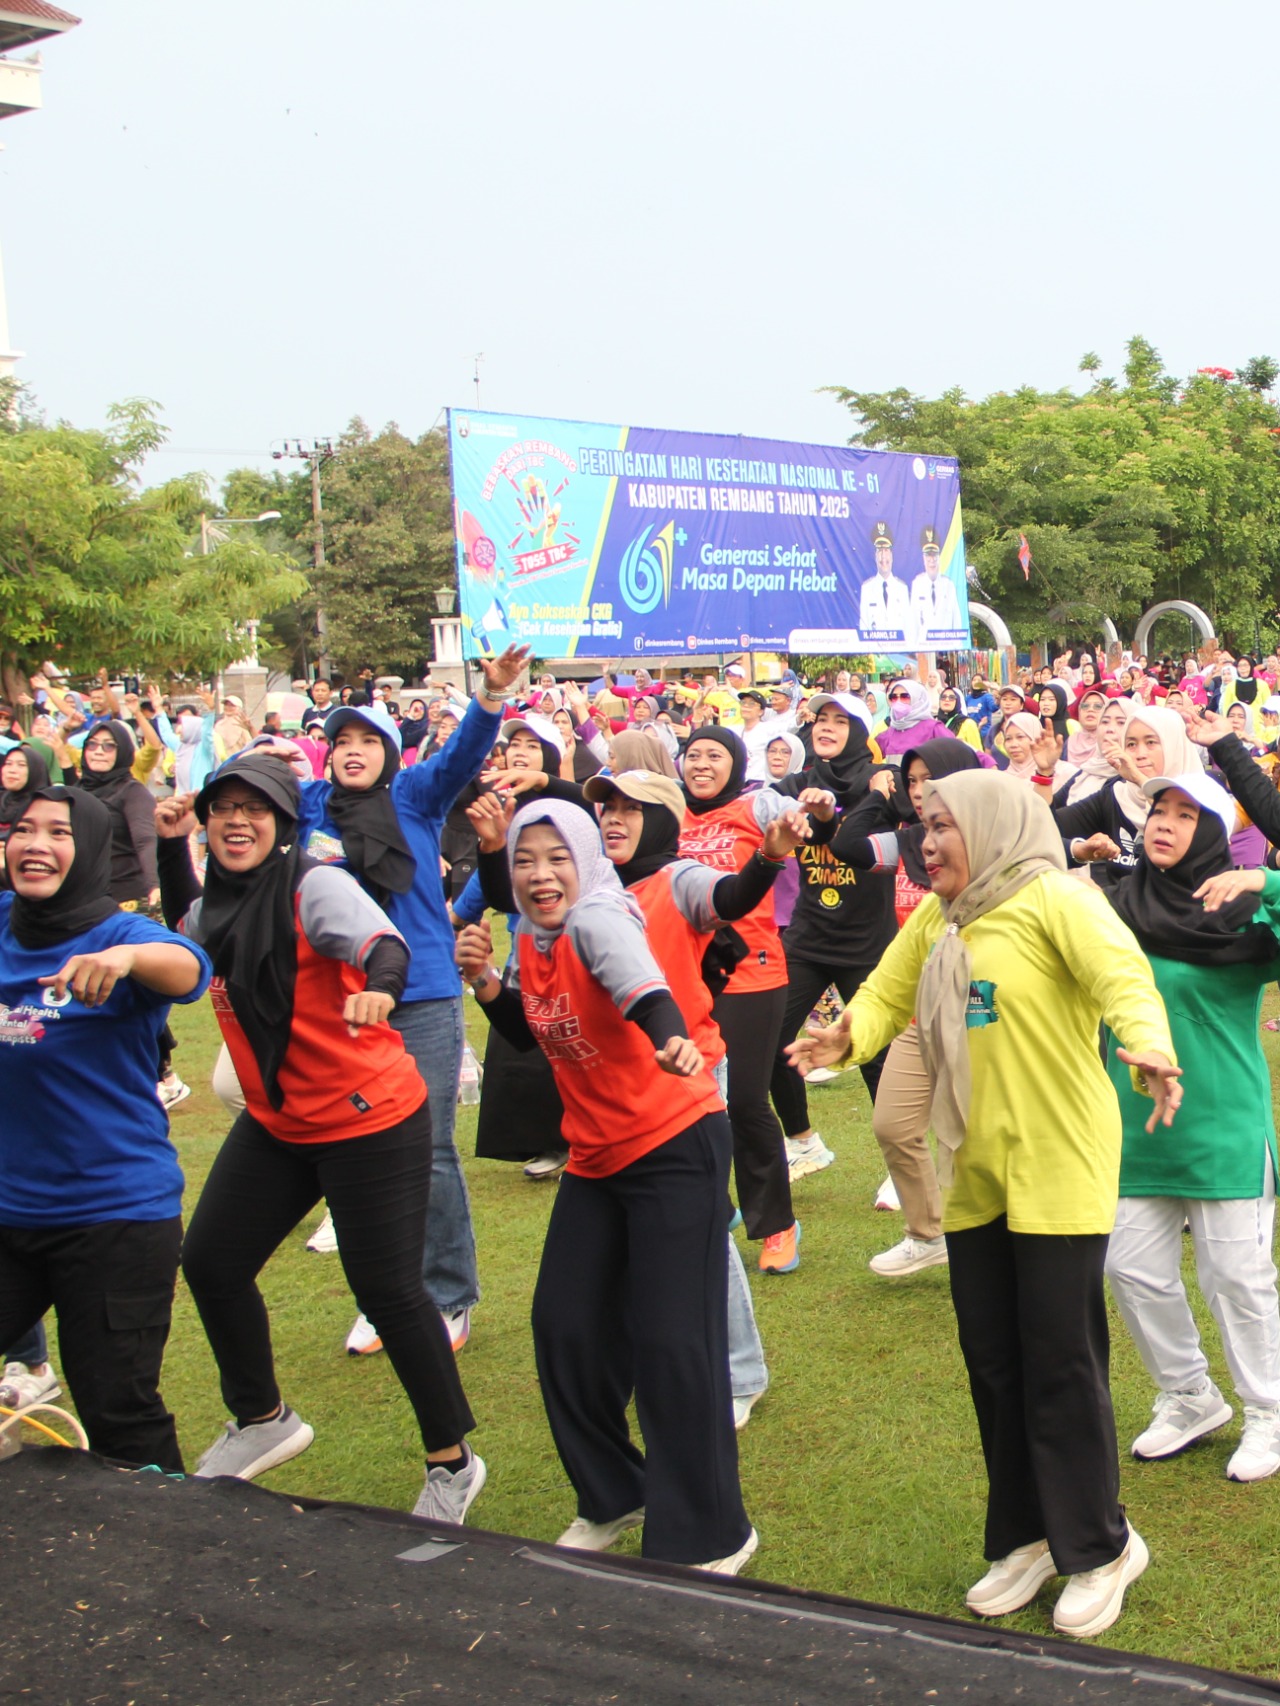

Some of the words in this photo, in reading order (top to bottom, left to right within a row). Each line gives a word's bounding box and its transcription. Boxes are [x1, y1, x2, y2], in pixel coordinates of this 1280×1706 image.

[482, 441, 524, 502] BEBASKAN
[523, 440, 578, 474] REMBANG
[504, 458, 527, 481] DARI
[525, 455, 545, 468] TBC
[579, 447, 668, 479] PERINGATAN
[670, 455, 703, 481] HARI
[705, 457, 777, 486] KESEHATAN
[780, 462, 840, 491] NASIONAL
[841, 469, 857, 492] KE
[866, 473, 880, 494] 61
[628, 482, 707, 511] KABUPATEN
[709, 487, 775, 514] REMBANG
[777, 492, 817, 517] TAHUN
[820, 494, 850, 519] 2025
[520, 554, 547, 573] TOSS
[548, 545, 567, 561] TBC
[700, 543, 769, 567] Generasi
[773, 544, 817, 568] Sehat
[682, 567, 727, 590] Masa
[732, 568, 785, 597] Depan
[789, 569, 838, 592] Hebat
[508, 603, 530, 622] Ayo
[531, 603, 590, 620] Sukseskan
[591, 602, 613, 620] CKG
[543, 621, 592, 637] Kesehatan
[592, 620, 623, 639] Gratis)
[697, 638, 714, 646] Dinkes
[714, 637, 738, 646] Rembang
[806, 866, 857, 886] ZUMBA
[22, 1005, 61, 1020] Health
